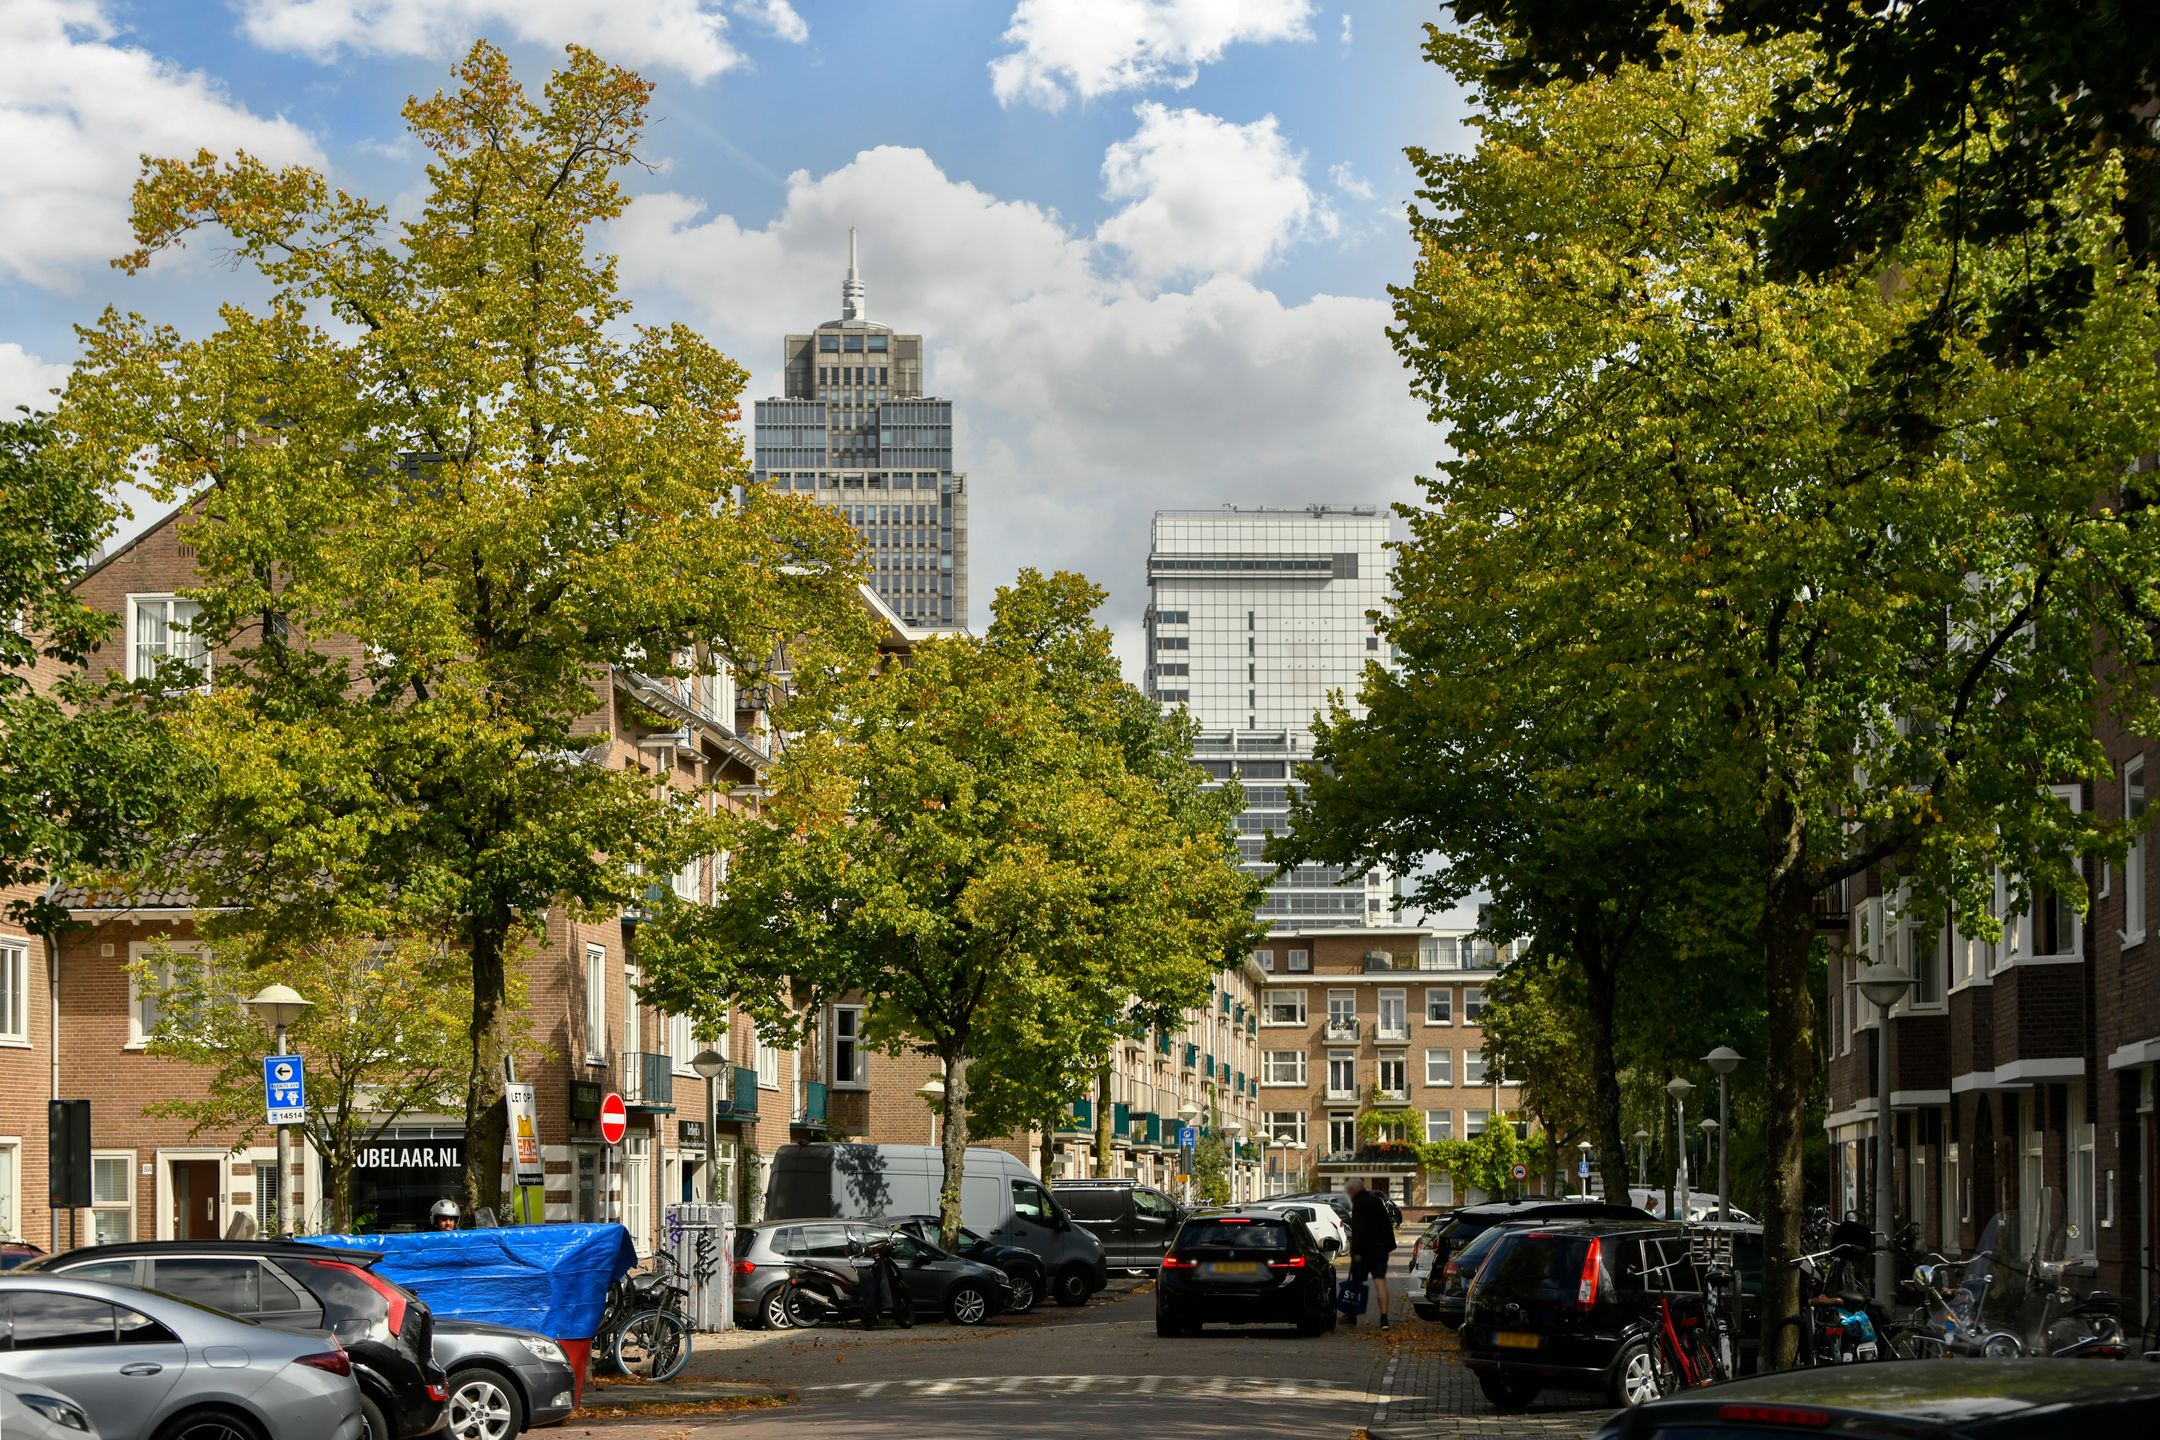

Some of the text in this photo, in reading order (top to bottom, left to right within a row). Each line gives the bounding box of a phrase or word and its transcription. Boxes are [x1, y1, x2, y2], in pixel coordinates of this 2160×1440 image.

[511, 1092, 534, 1103] LET OP!
[330, 1147, 461, 1168] UBELAAR.NL
